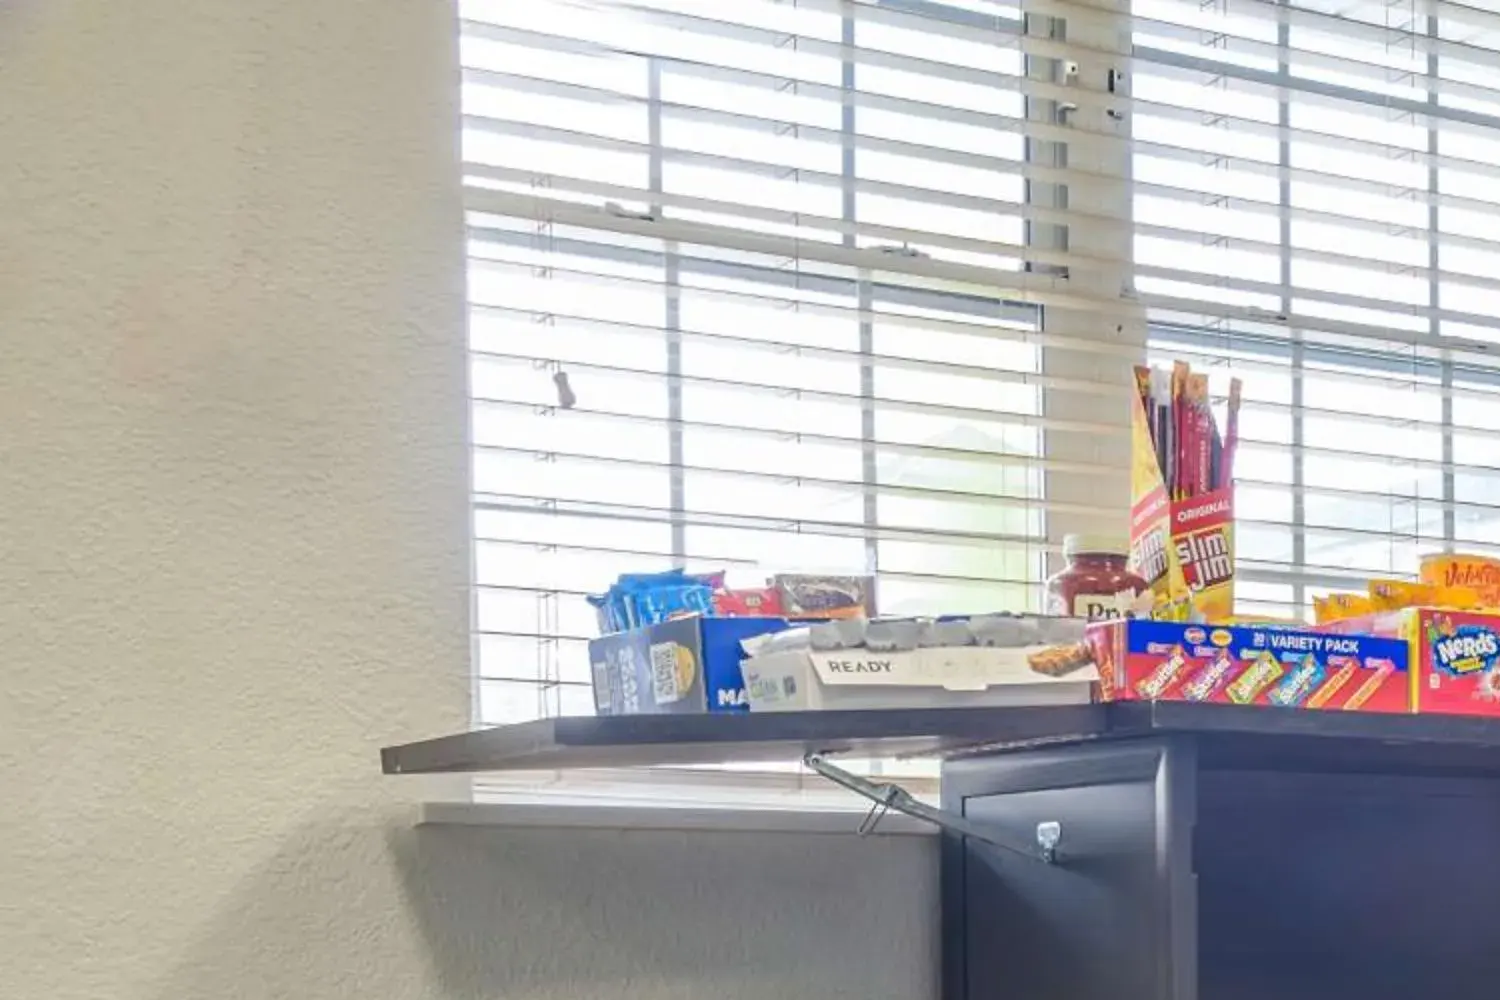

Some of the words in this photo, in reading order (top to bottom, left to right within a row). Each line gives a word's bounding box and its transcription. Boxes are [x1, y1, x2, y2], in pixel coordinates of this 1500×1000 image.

[1271, 634, 1323, 652] VARIETY
[1325, 637, 1359, 653] PACK
[829, 659, 894, 674] READY
